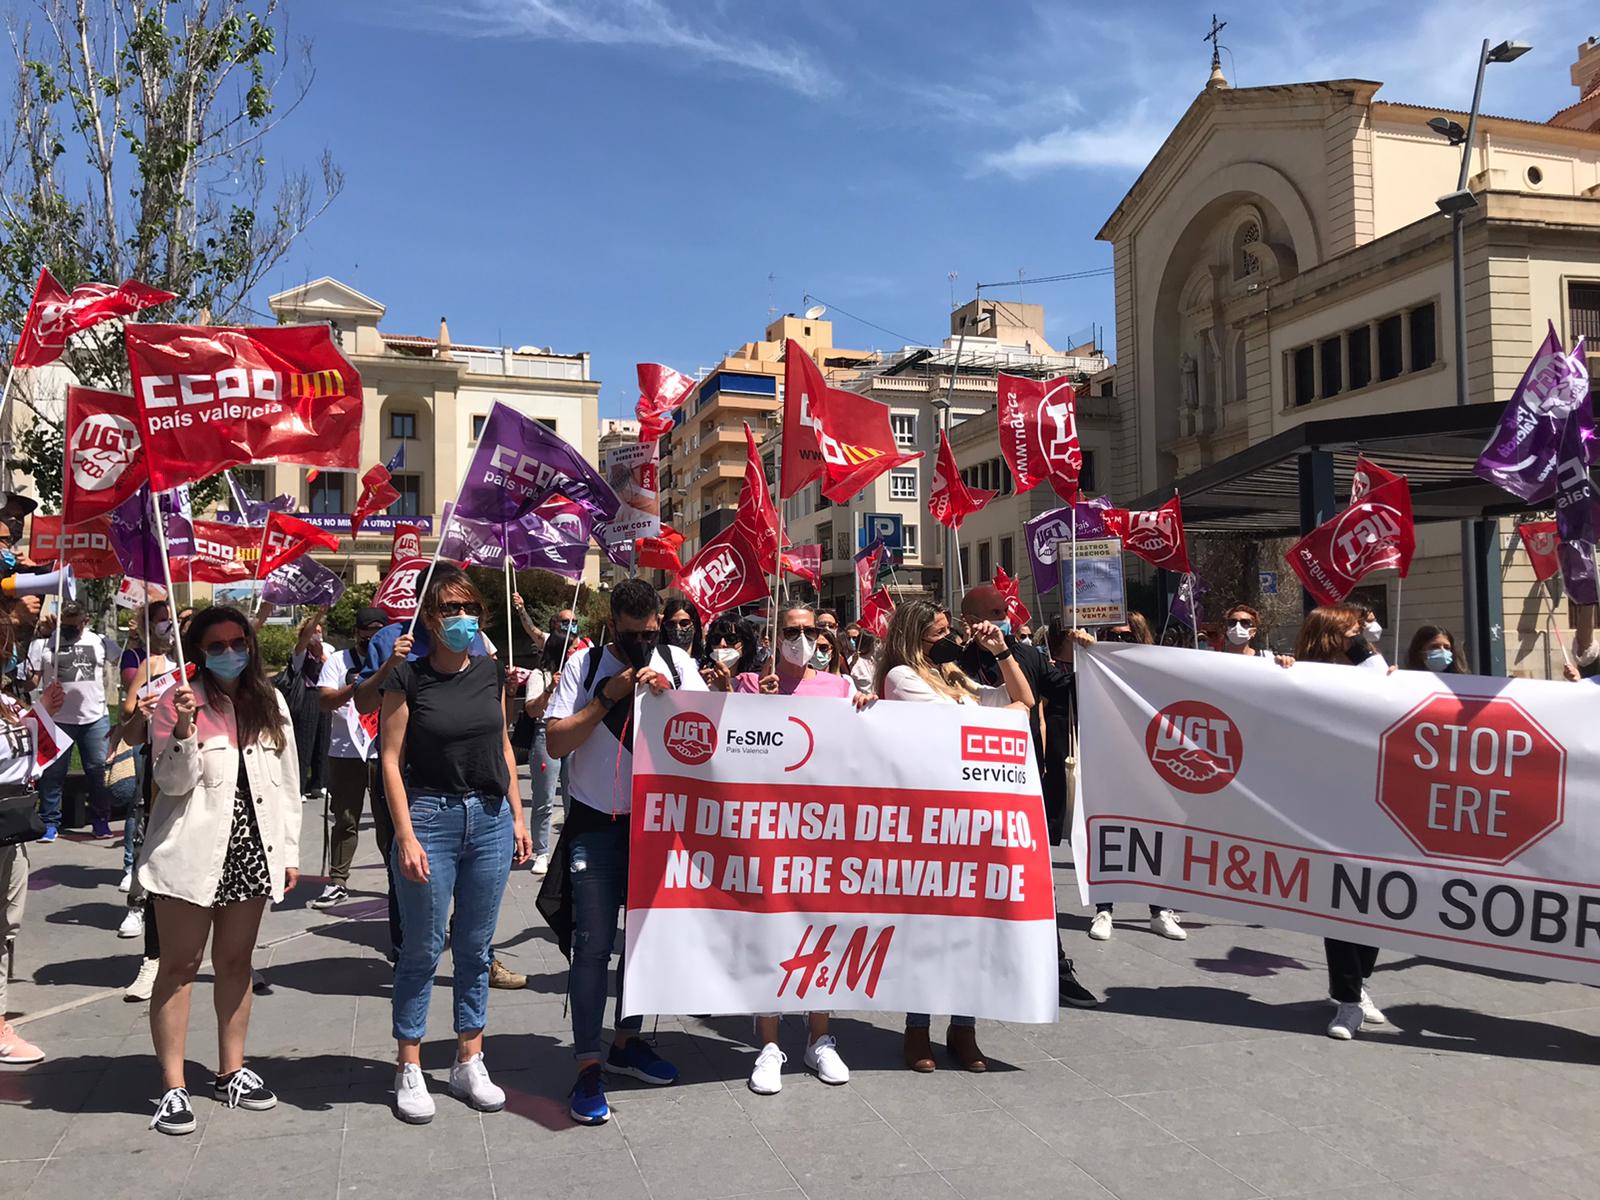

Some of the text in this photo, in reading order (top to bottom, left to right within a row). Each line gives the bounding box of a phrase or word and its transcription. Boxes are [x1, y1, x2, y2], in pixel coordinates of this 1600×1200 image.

[140, 368, 283, 409] CCOO
[148, 402, 283, 435] país valencia
[78, 423, 134, 452] UGT
[324, 518, 336, 527] NO
[370, 519, 391, 528] OTRO
[613, 521, 652, 533] LOW COST
[874, 518, 895, 541] P
[36, 532, 108, 551] CCOO
[194, 538, 234, 560] COO
[671, 719, 711, 744] UGT
[726, 729, 784, 746] FeSMC
[967, 734, 1027, 757] CCOO
[1156, 713, 1231, 758] UGT
[1413, 721, 1533, 778] STOP
[962, 764, 1026, 785] servicios
[643, 793, 1037, 852] EN DEFENSA DEL EMPLEO,
[1426, 783, 1510, 838] ERE
[664, 849, 1025, 901] NO AL ERE SALVAJE DE
[1099, 825, 1163, 876] EN
[1183, 835, 1309, 903] H&M
[1331, 863, 1418, 920] NO
[777, 925, 895, 999] H&M
